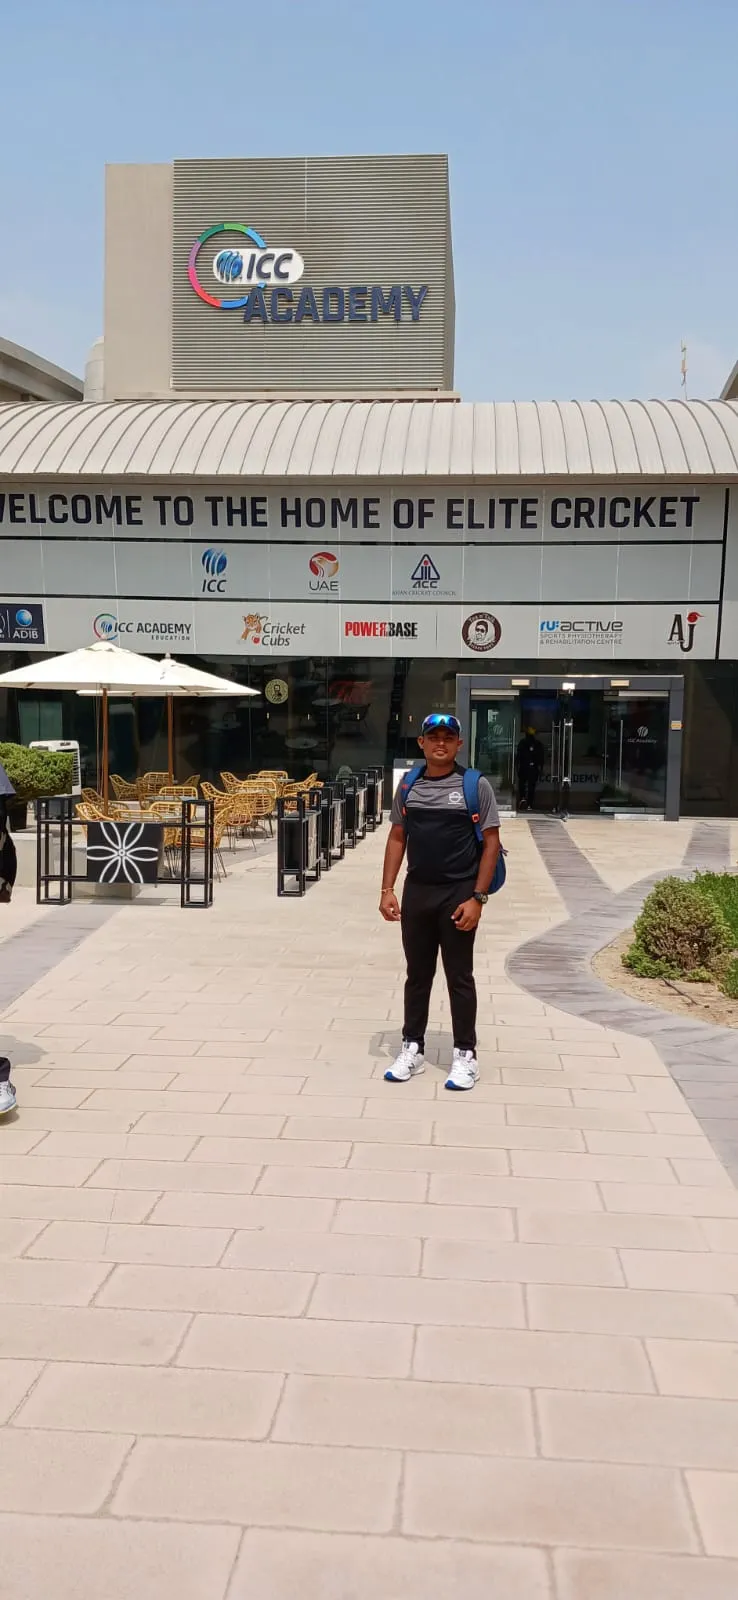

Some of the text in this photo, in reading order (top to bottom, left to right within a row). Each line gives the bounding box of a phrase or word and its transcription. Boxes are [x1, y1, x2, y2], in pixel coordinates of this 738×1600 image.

[247, 253, 293, 279] ICC
[243, 286, 428, 322] ACADEMY
[152, 496, 193, 526] TO
[205, 496, 267, 527] THE
[281, 497, 380, 528] HOME
[393, 498, 435, 529] OF
[446, 498, 538, 529] ELITE
[550, 496, 700, 528] CRICKET
[202, 579, 226, 592] ICC
[309, 580, 339, 591] UAE
[412, 580, 438, 588] ACC
[114, 622, 191, 634] ICC ACADEMY
[262, 622, 306, 634] Cricket
[13, 630, 39, 639] ADIB
[261, 634, 290, 646] Cubs
